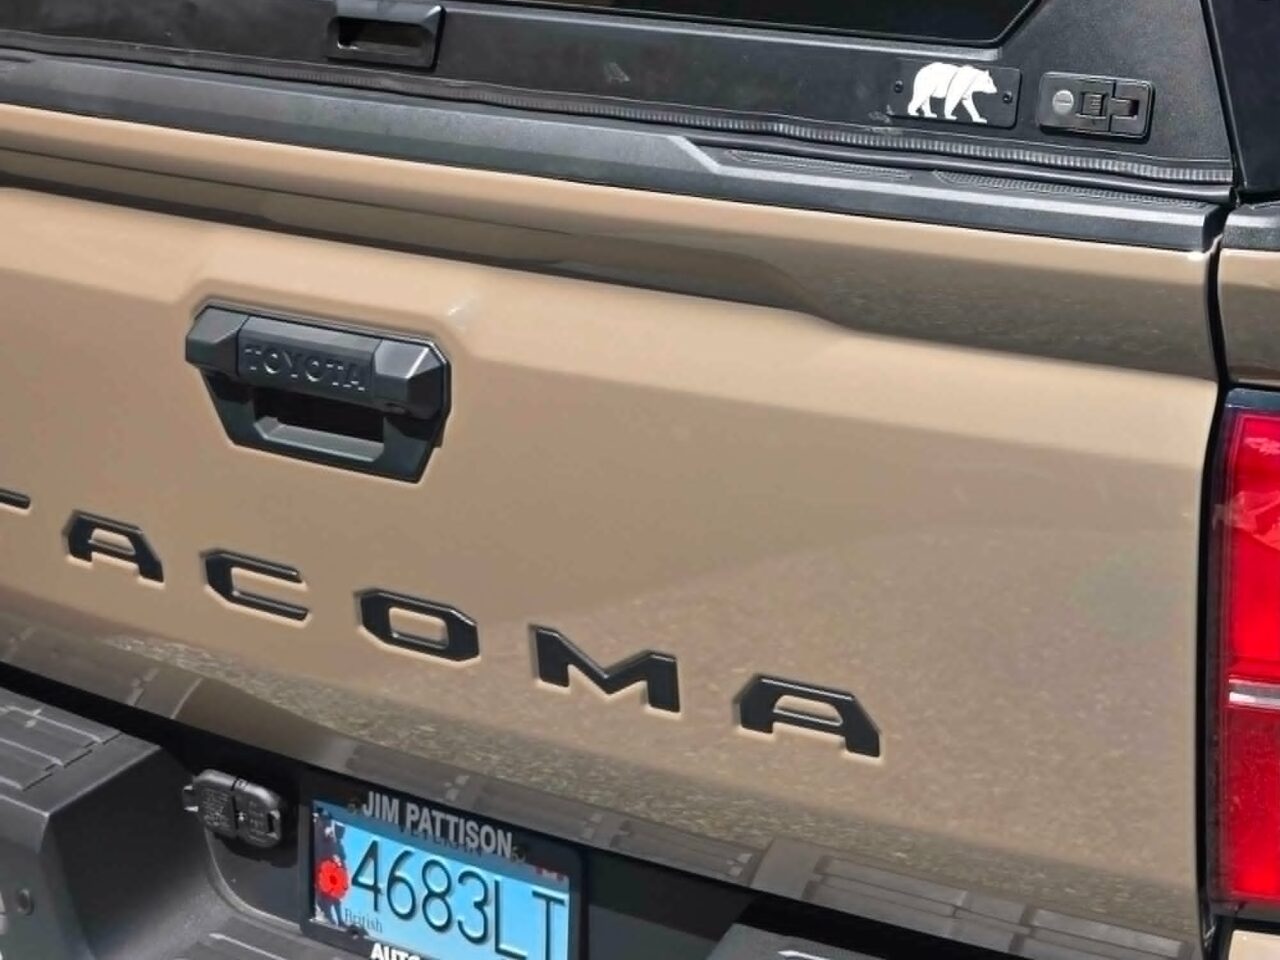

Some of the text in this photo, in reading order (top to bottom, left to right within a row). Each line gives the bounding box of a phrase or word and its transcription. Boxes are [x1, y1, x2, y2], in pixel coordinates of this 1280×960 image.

[244, 345, 367, 392] TOYOTA
[362, 790, 400, 825] JIM
[405, 802, 513, 859] PATTISON
[351, 839, 567, 960] 4683LT
